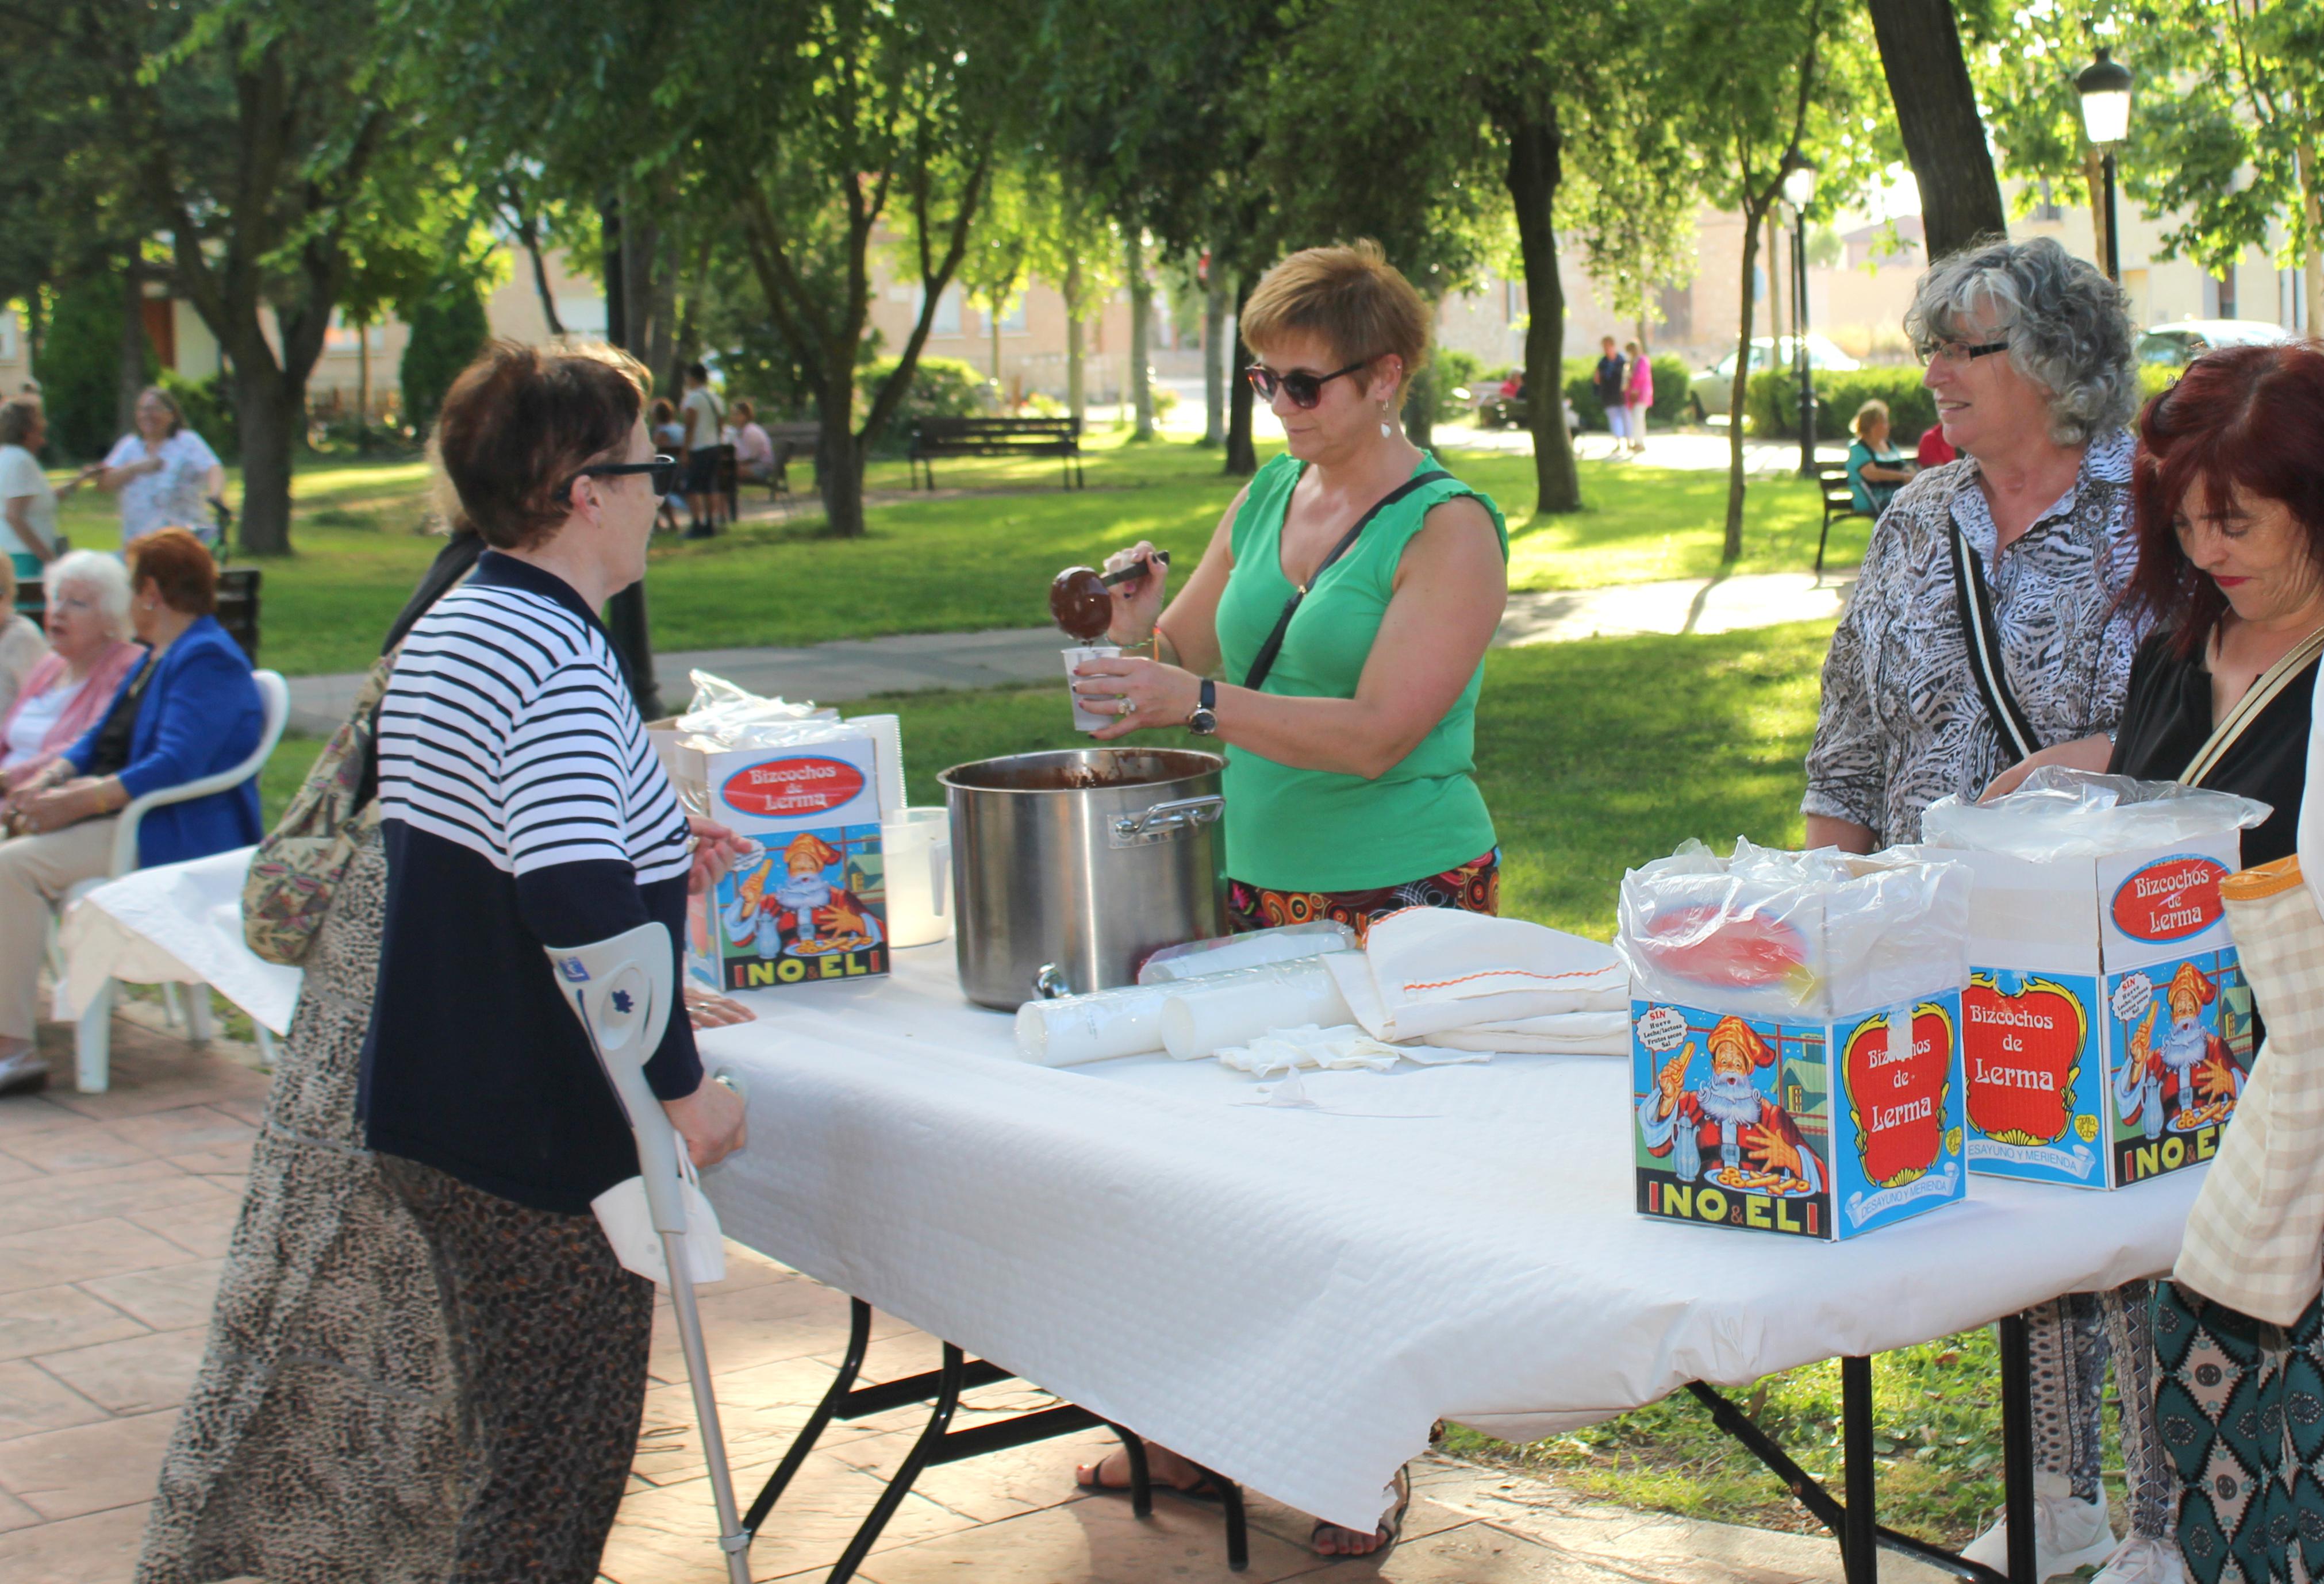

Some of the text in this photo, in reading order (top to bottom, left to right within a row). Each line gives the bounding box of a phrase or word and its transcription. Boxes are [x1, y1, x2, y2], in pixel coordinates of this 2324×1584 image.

[748, 765, 836, 785] Bizcochos
[785, 783, 803, 794] de
[765, 793, 827, 810] Lerma
[2134, 868, 2209, 898] Bizcochos
[2168, 895, 2181, 909] de
[2149, 906, 2202, 933] Lerma
[2122, 978, 2135, 991] SIN
[1650, 1010, 1666, 1021] SIN
[1970, 1005, 2053, 1029] Bizcochos
[1643, 1024, 1682, 1039] Leche/lactosa
[1650, 1020, 1671, 1029] Huevo
[1647, 1032, 1682, 1045] Frutos secos
[2003, 1034, 2023, 1052] de
[1893, 1070, 1908, 1087] de
[1975, 1058, 2054, 1091] Lerma
[1872, 1096, 1931, 1133] Lerma
[1968, 1144, 2077, 1172] ESAYUNO Y MERIENDA
[1861, 1181, 1946, 1218] DESAYUNO Y MERIENDA
